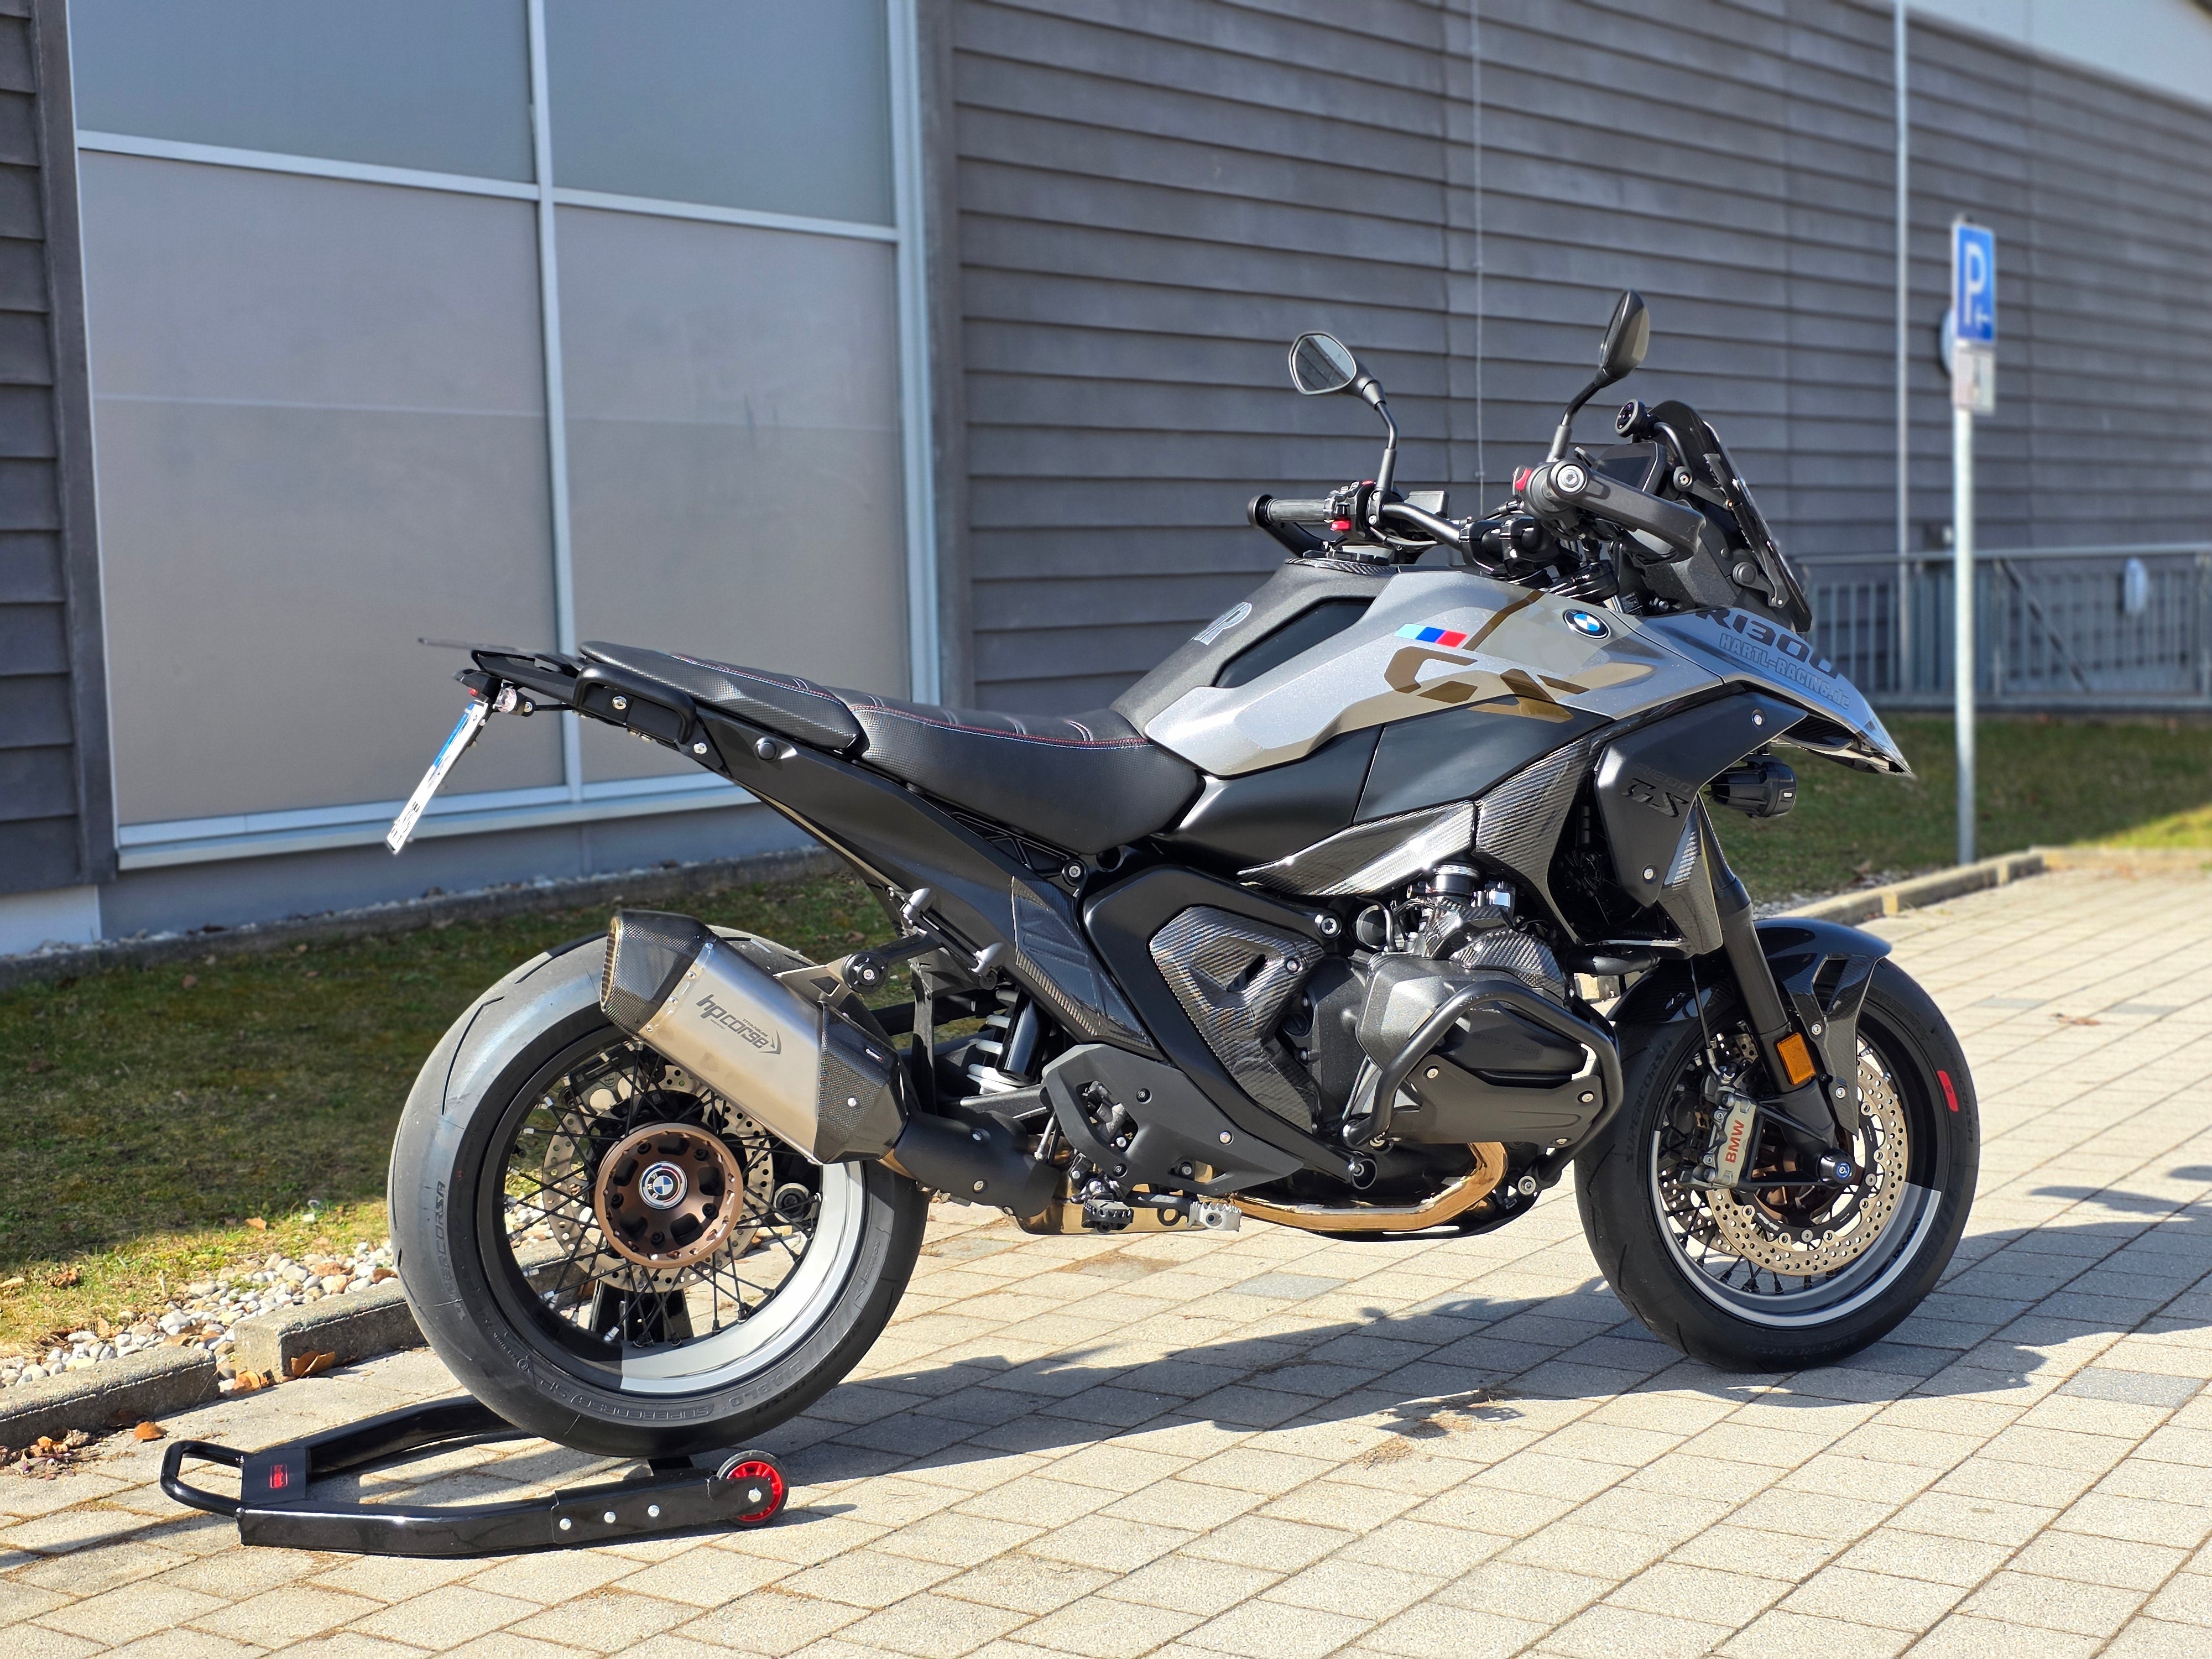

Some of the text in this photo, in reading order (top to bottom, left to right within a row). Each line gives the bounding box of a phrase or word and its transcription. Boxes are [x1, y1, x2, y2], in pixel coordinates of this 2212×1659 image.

[1964, 241, 1986, 326] P
[1719, 633, 1850, 711] HARTL-RACING.de
[1725, 1119, 1745, 1164] BMW
[578, 1395, 709, 1420] SUPERCORSA
